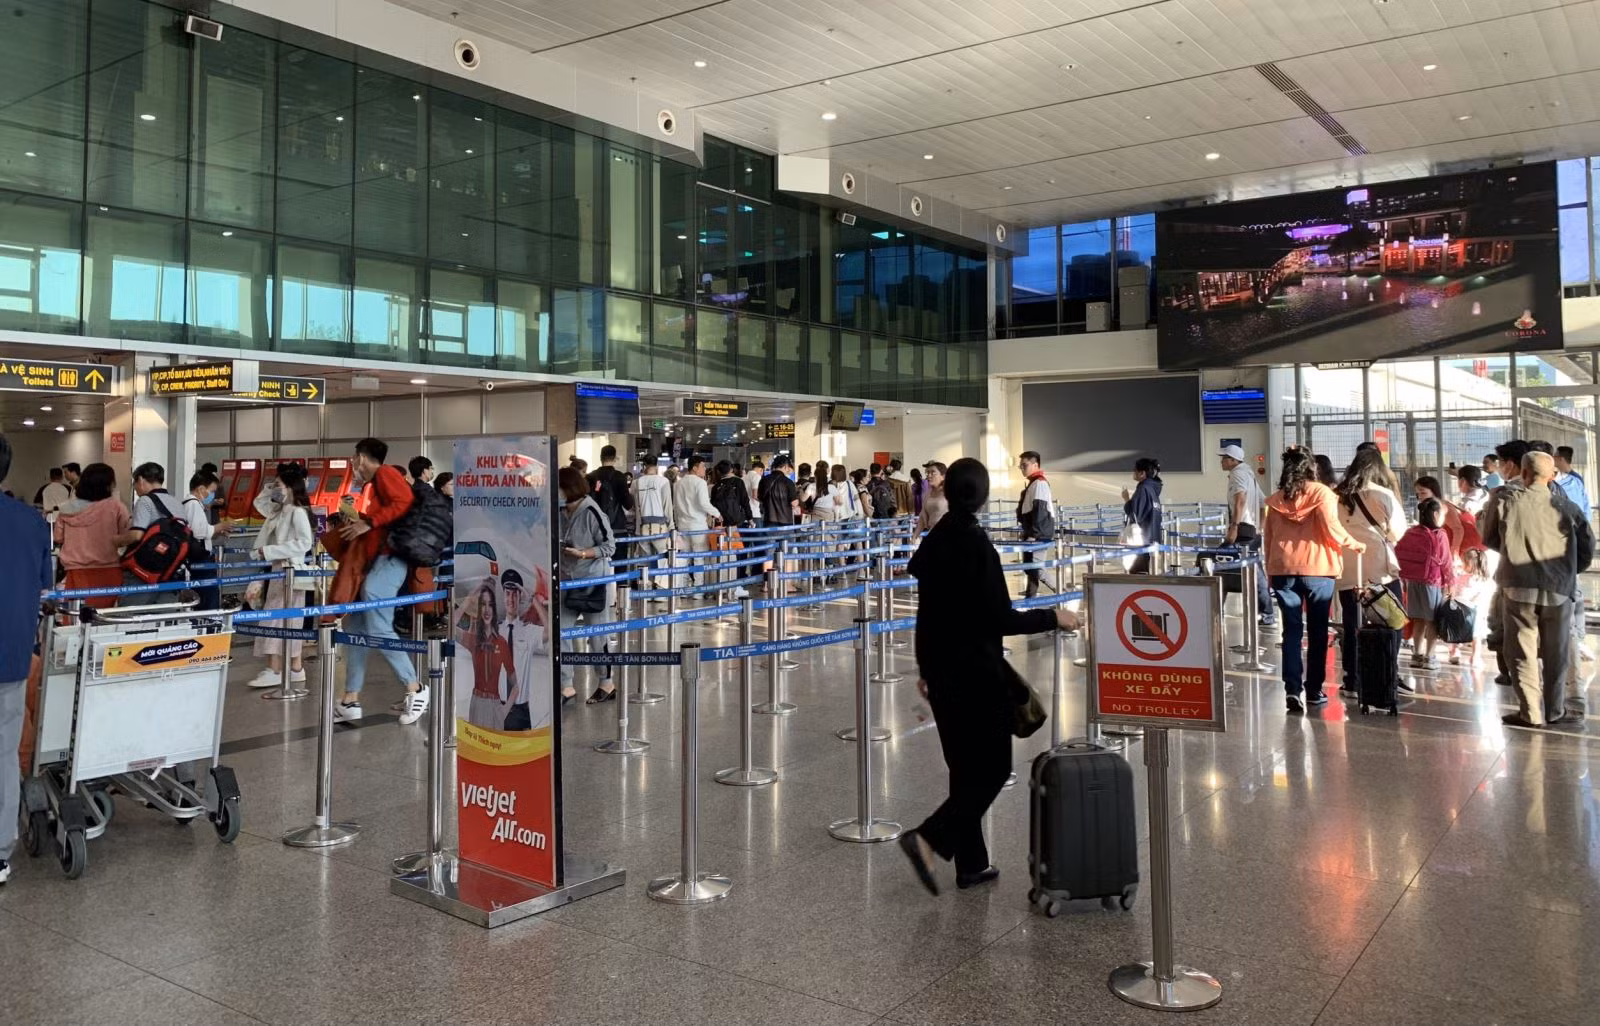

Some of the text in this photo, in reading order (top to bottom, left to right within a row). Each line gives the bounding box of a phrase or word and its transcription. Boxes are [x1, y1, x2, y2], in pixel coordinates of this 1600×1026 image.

[11, 364, 26, 377] VỆ
[28, 366, 54, 376] SINH
[22, 376, 54, 386] Toilets
[261, 381, 280, 389] NINH
[259, 390, 280, 398] Check
[477, 456, 497, 468] KHU
[456, 468, 479, 487] KIỂM
[481, 475, 499, 487] TRA
[502, 475, 516, 487] AN
[460, 496, 540, 507] SECURITY CHECK POINT
[648, 617, 664, 625] TIA
[348, 635, 366, 645] TIA
[713, 649, 734, 658] TIA
[762, 643, 776, 651] CẢNG
[777, 641, 791, 650] HÀNG
[792, 639, 810, 648] KHÔNG
[811, 636, 824, 645] QUỐC
[831, 633, 841, 641] TÂN
[157, 644, 182, 655] QUẢNG
[183, 642, 198, 650] CÁO
[563, 653, 678, 663] KHÔNG QUỐC TẾ TÂN SƠN NHẤT
[1102, 670, 1202, 684] KHÔNG DÙNG
[1126, 684, 1182, 695] XE ĐẨY
[1112, 703, 1200, 716] NO TROLLEY
